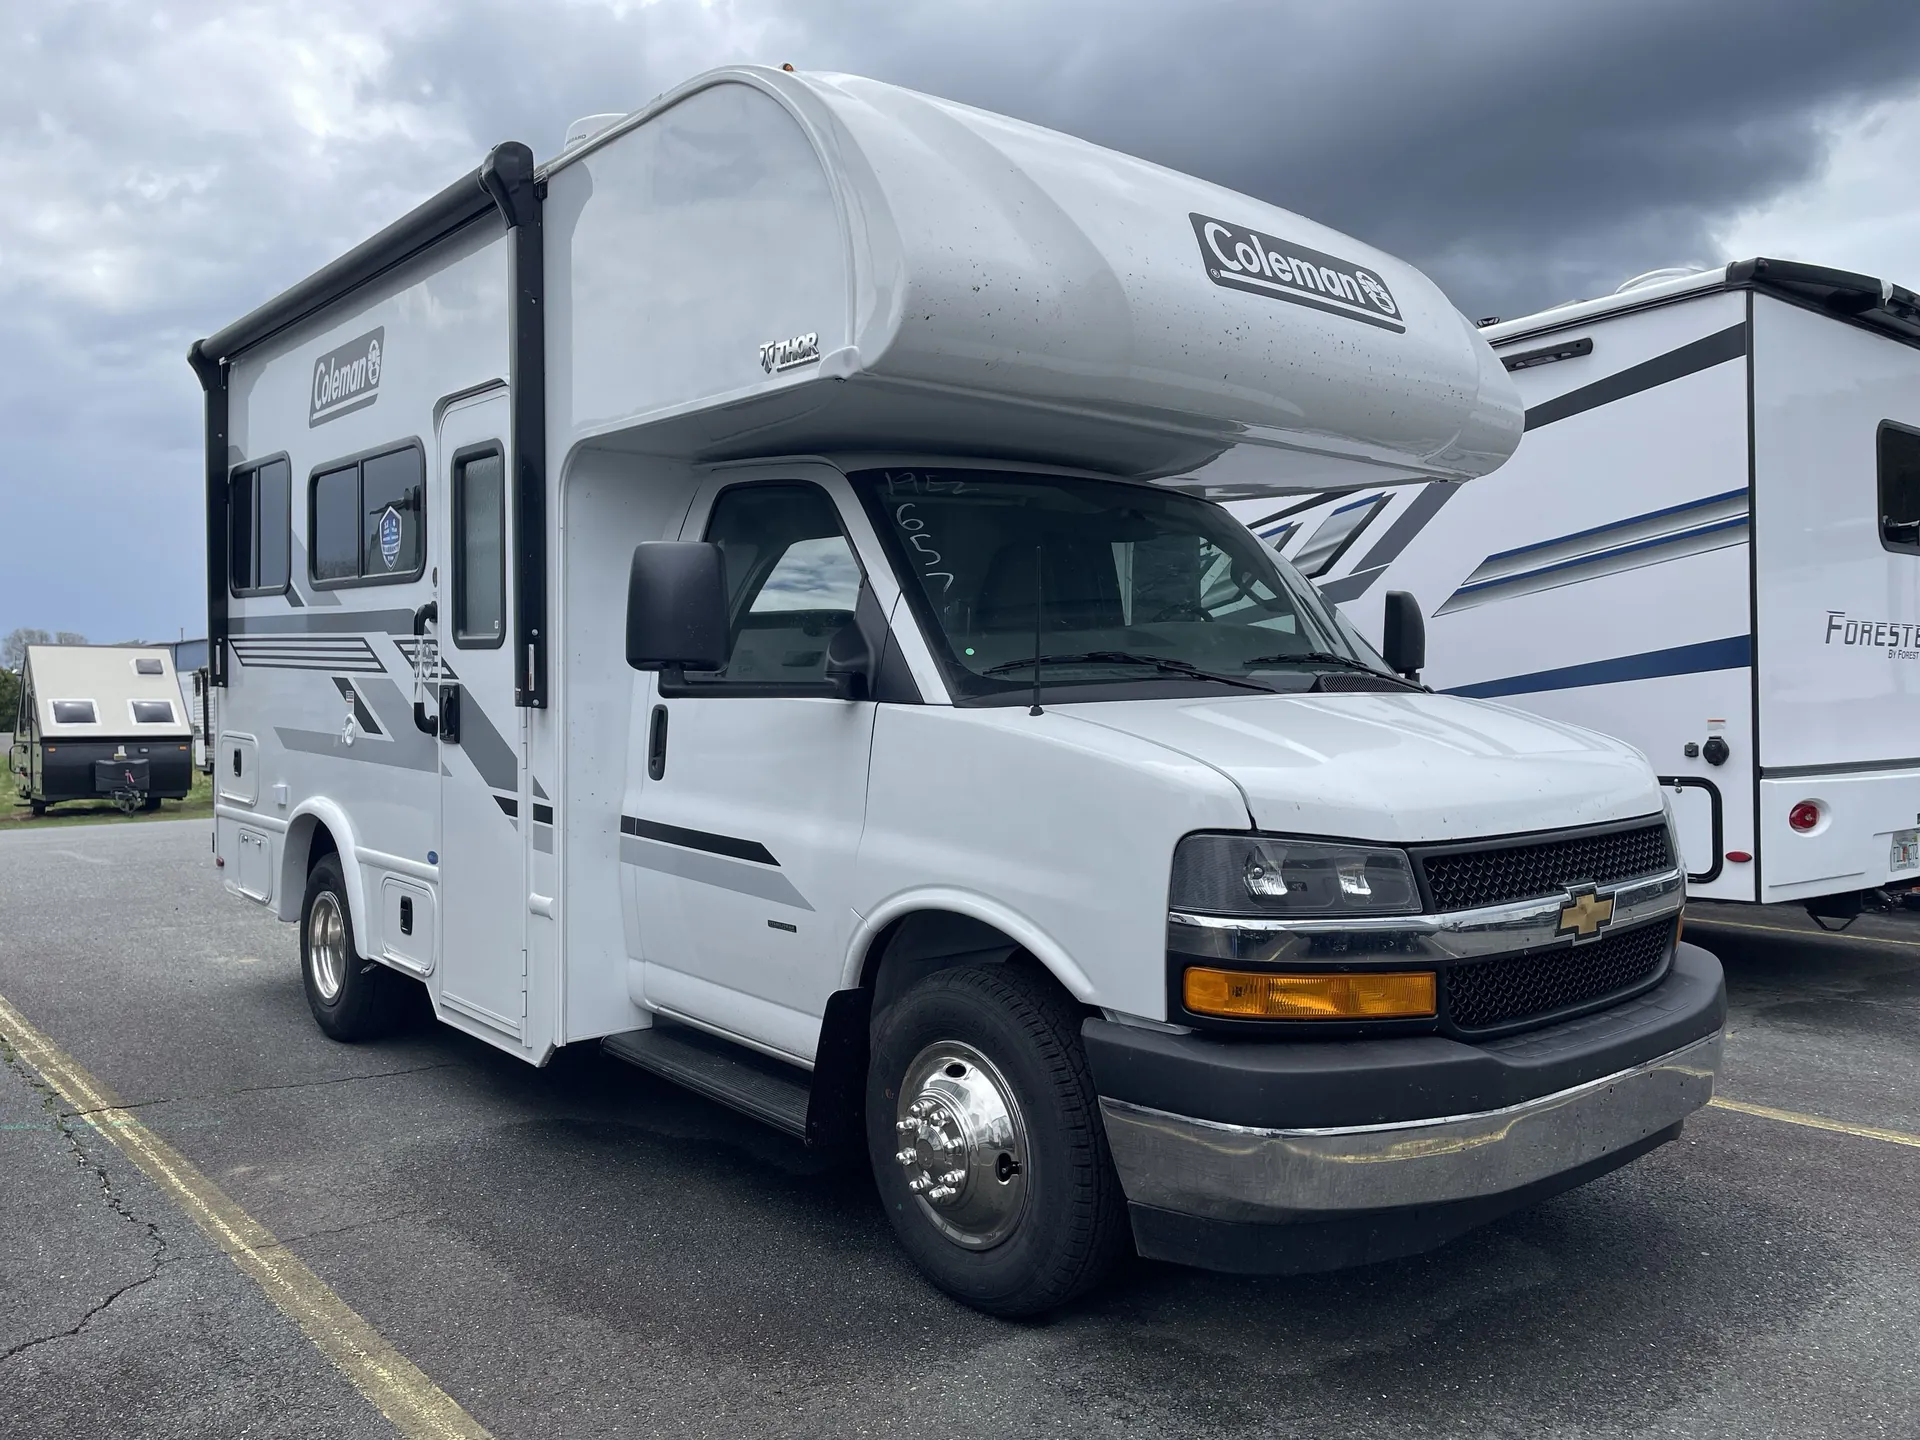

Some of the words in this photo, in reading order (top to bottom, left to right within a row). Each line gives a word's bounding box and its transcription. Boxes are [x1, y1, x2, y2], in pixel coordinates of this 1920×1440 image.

[1204, 221, 1366, 304] Coleman
[776, 332, 820, 365] THOR
[314, 356, 367, 410] Coleman
